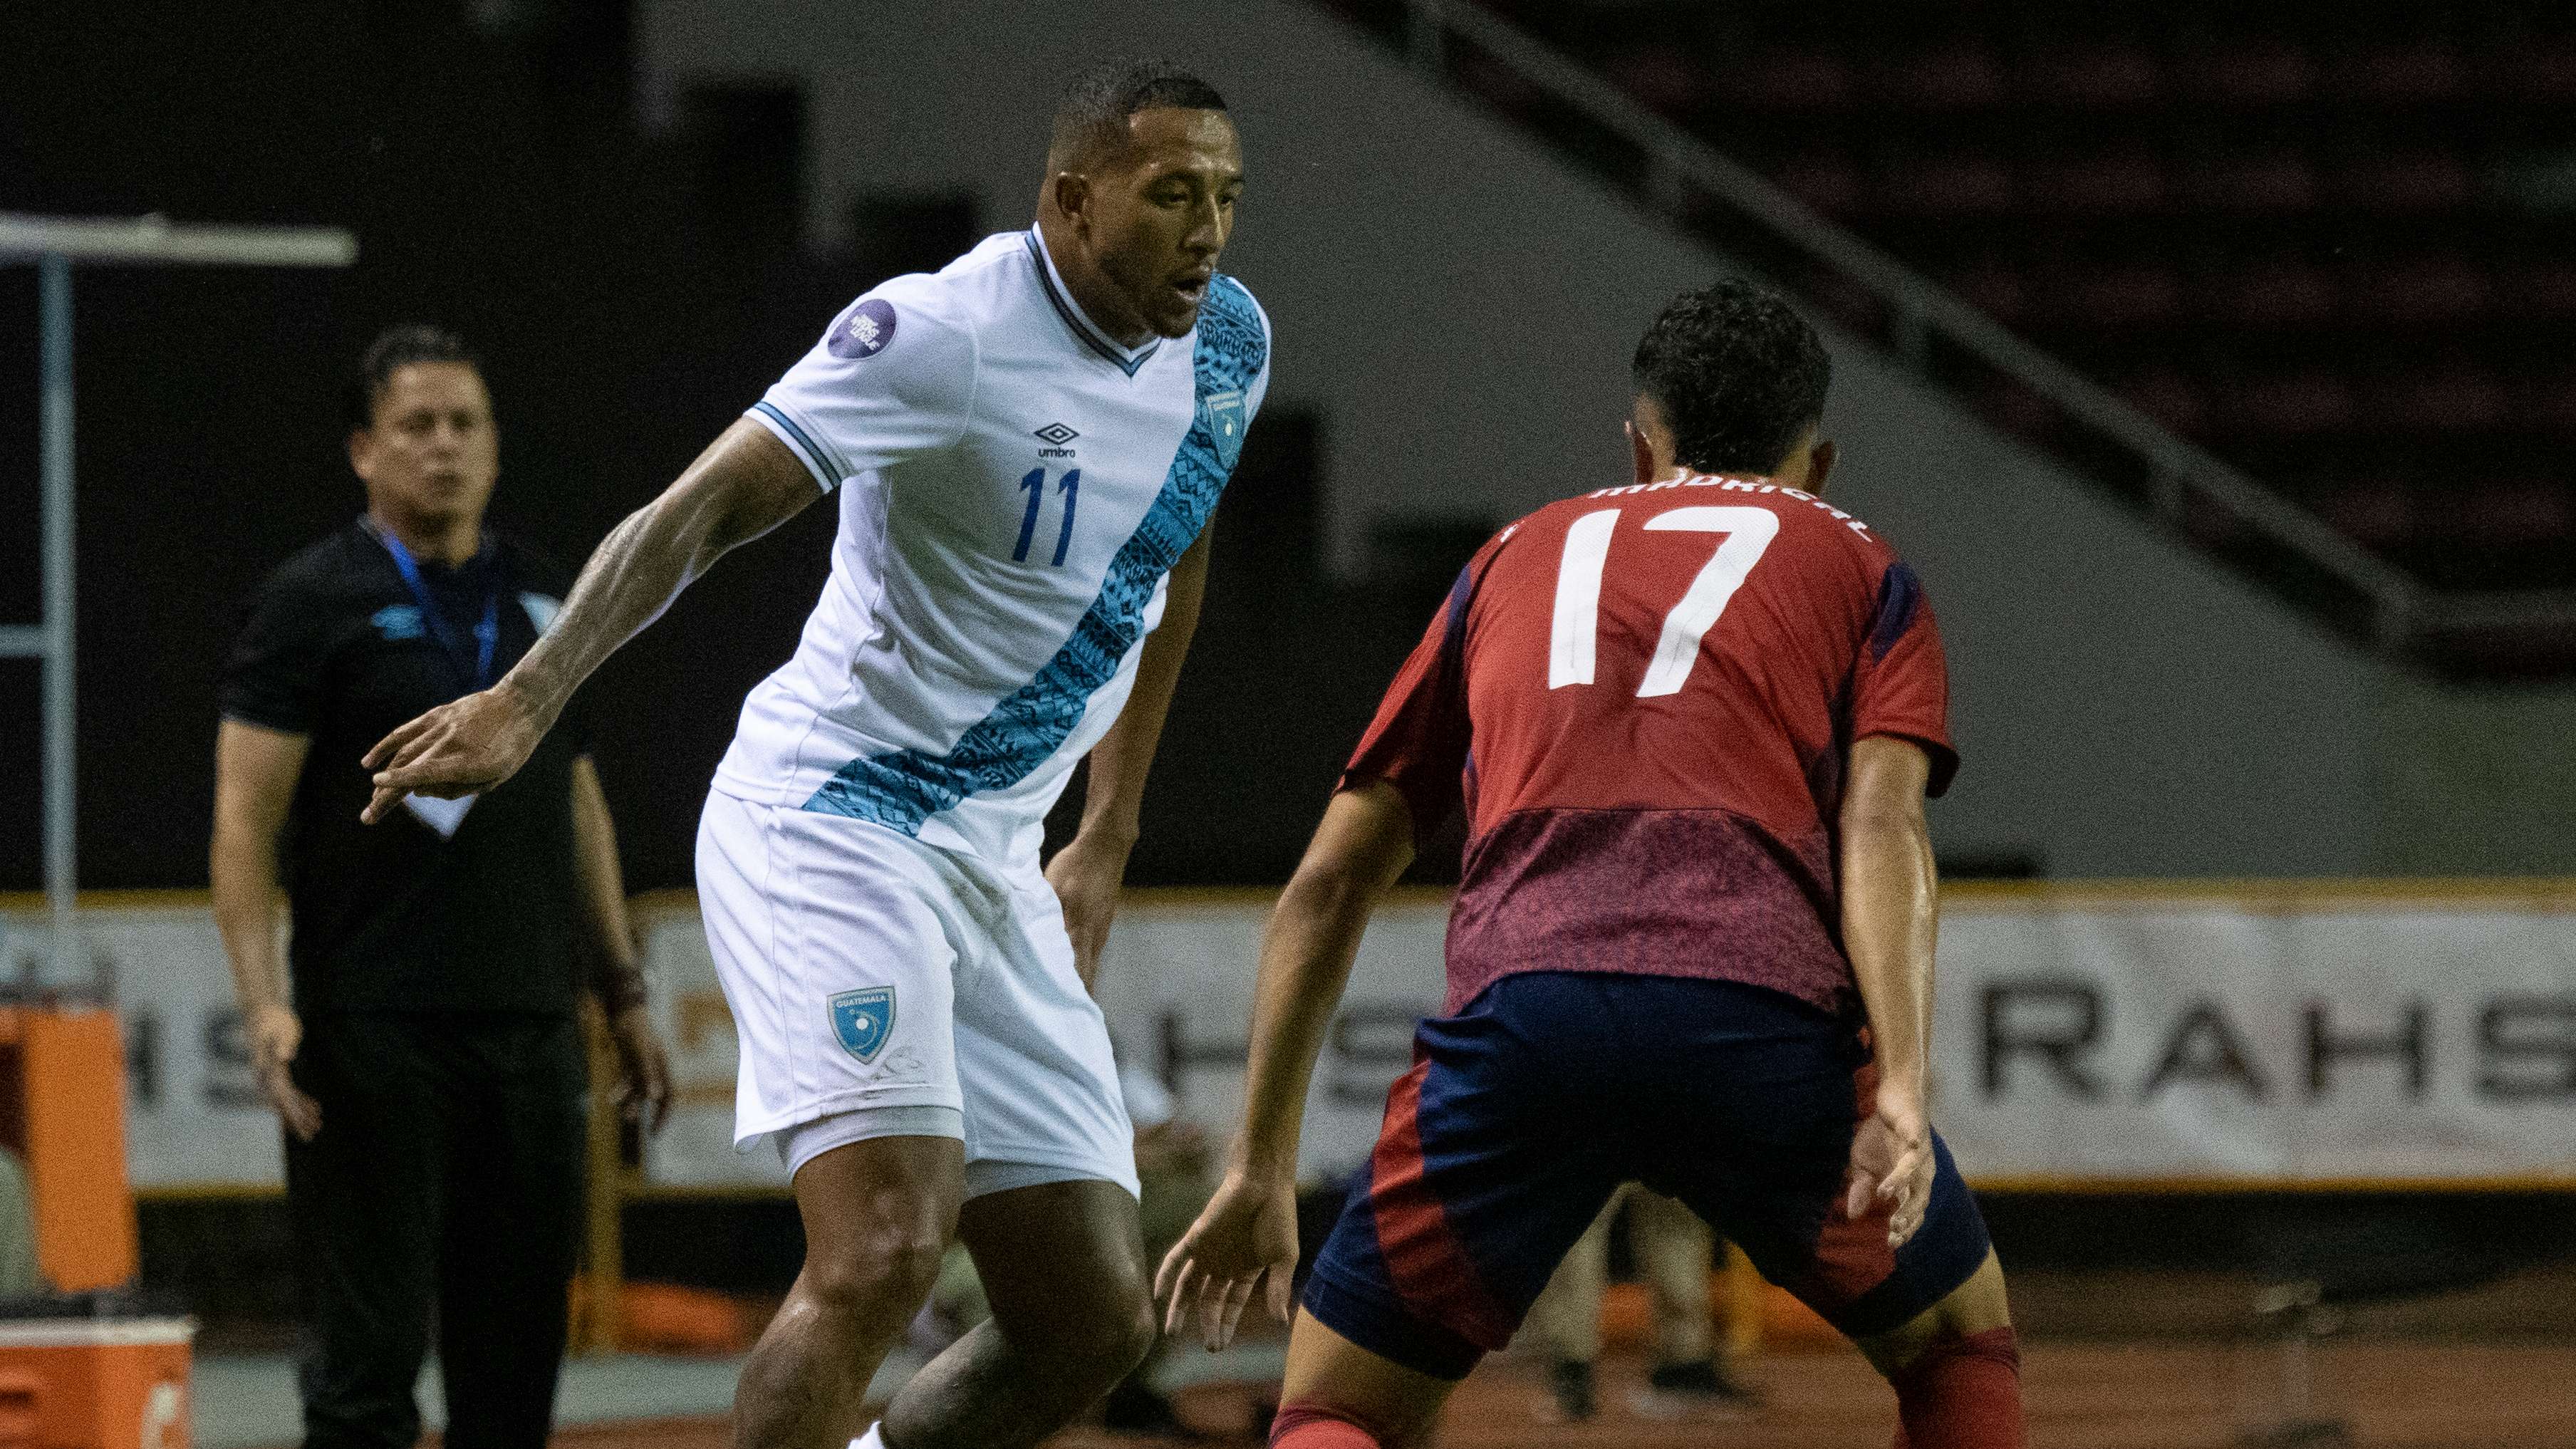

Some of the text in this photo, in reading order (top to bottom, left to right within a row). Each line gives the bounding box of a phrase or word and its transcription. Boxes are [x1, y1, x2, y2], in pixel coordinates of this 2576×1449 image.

[1038, 447, 1076, 457] umbro
[1012, 467, 1081, 566] 11
[1549, 507, 1780, 697] 17
